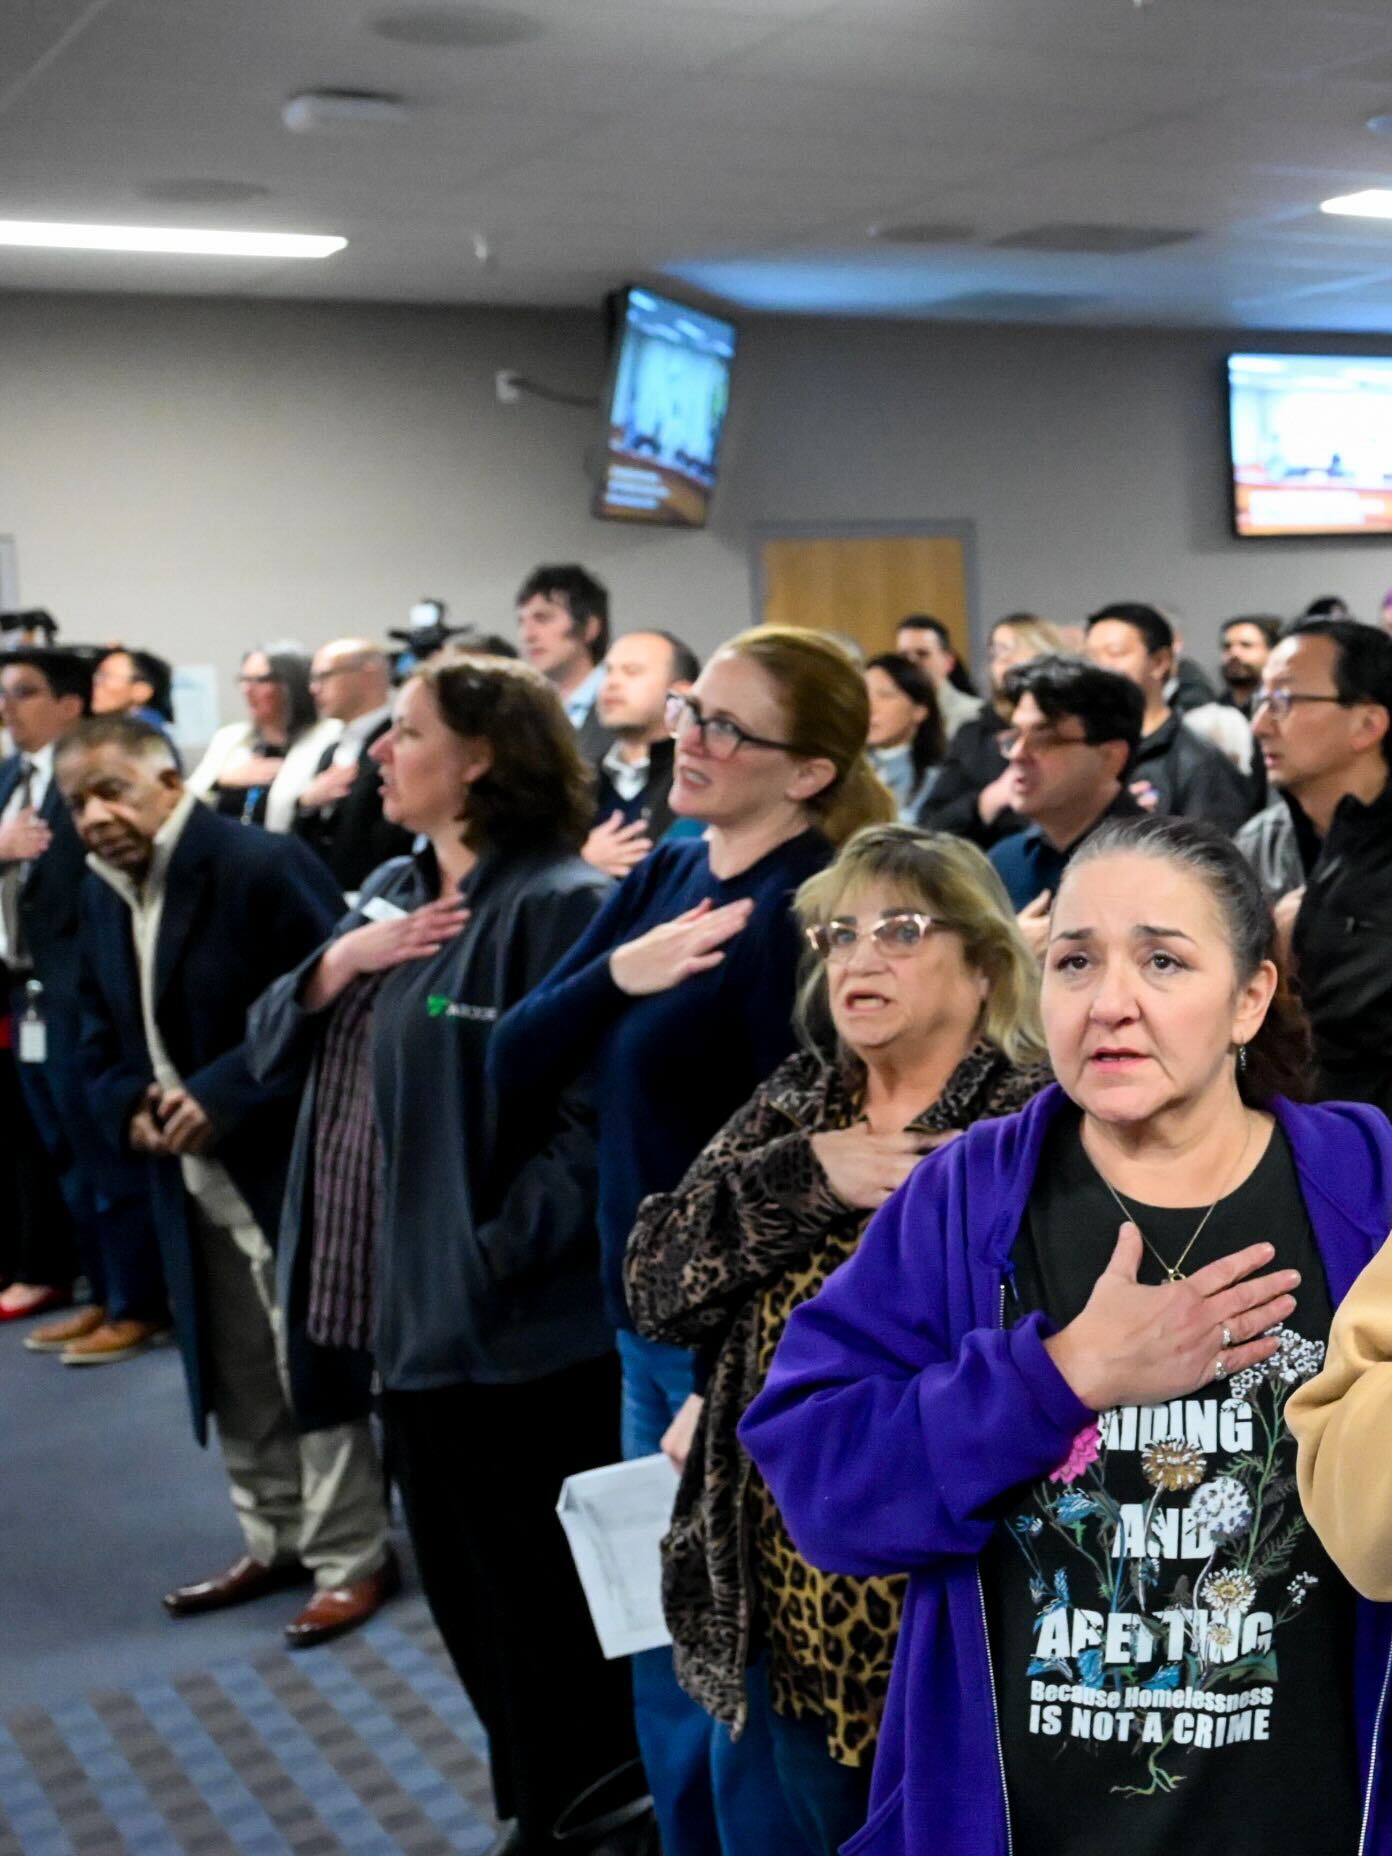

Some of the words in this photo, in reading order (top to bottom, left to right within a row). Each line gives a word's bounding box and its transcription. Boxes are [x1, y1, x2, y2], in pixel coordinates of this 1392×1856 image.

[1111, 1503, 1216, 1559] AND
[1030, 1680, 1121, 1708] Because
[1124, 1686, 1273, 1713] Homelessness
[1029, 1703, 1062, 1735] IS
[1070, 1706, 1135, 1742] NOT
[1141, 1711, 1163, 1743] A
[1173, 1709, 1271, 1749] CRIME
